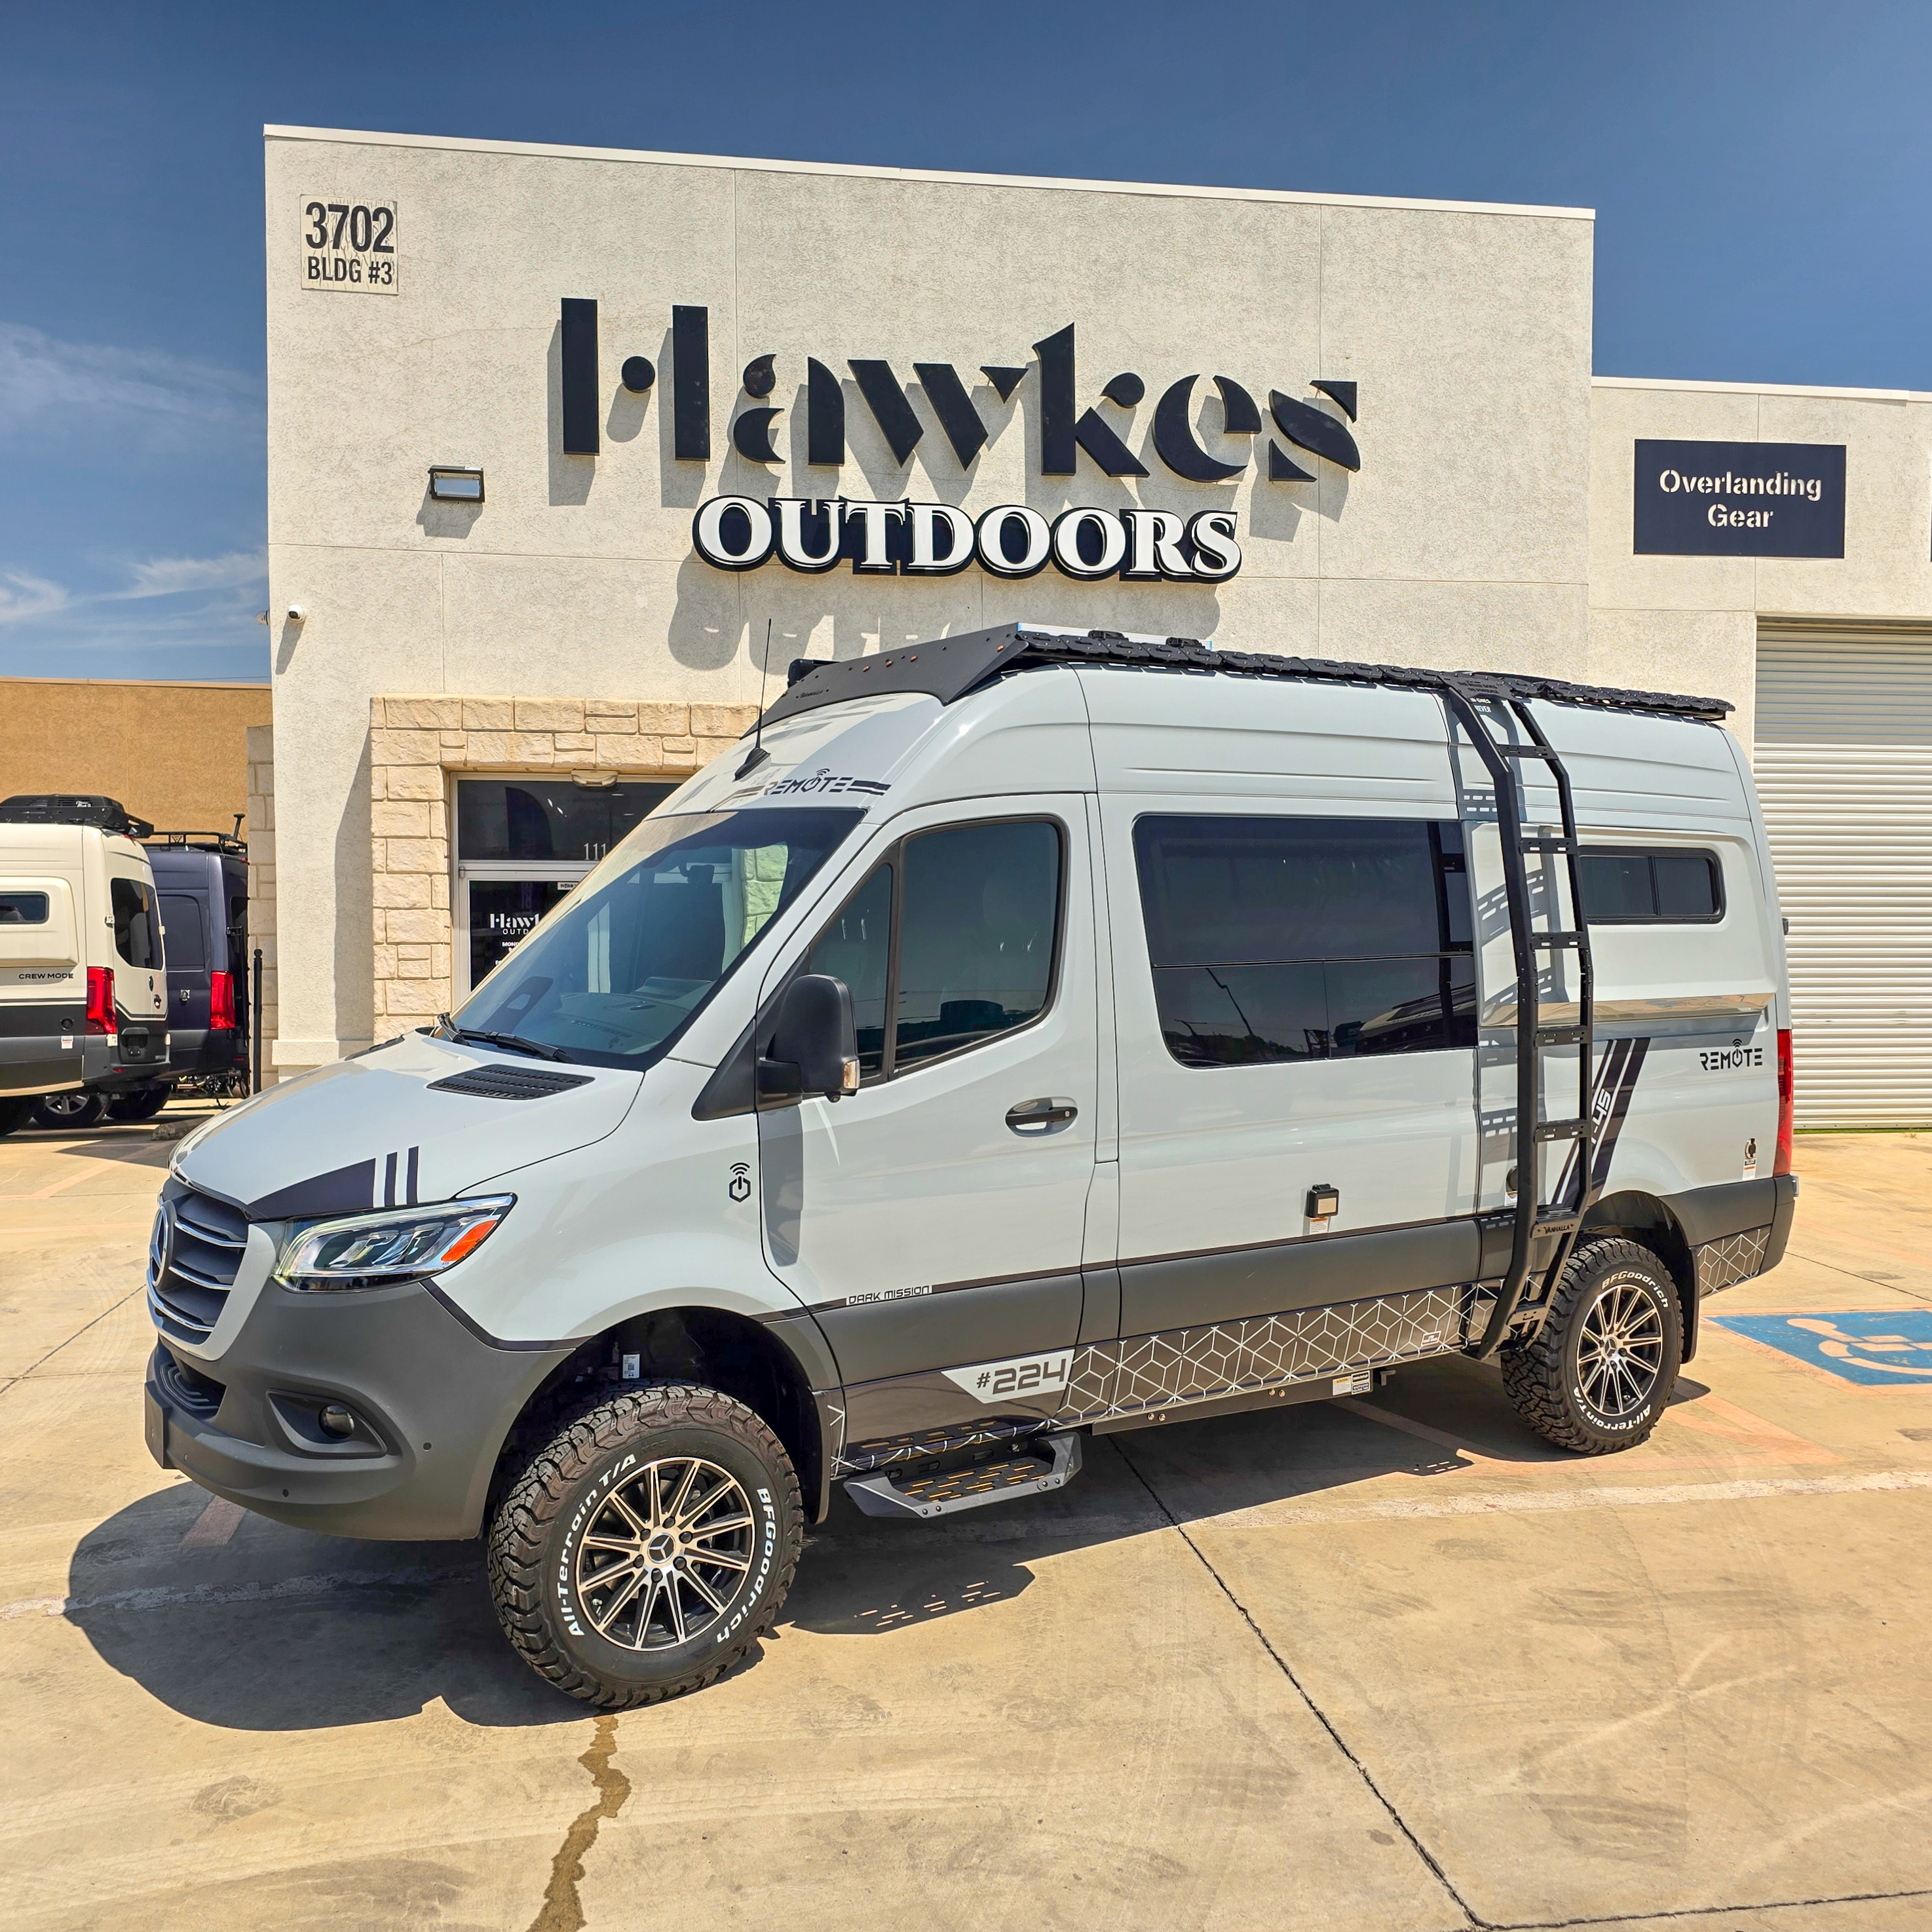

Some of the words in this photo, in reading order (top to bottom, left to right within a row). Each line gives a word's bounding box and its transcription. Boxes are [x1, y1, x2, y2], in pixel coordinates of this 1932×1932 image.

[305, 202, 394, 254] 3702
[308, 256, 362, 283] BLDG
[368, 261, 392, 285] #3
[561, 297, 1360, 483] Hawkes
[1659, 469, 1822, 502] Overlanding
[1707, 504, 1774, 528] Gear
[694, 495, 1243, 580] OUTDOORS
[764, 774, 854, 795] REMOTE
[490, 913, 539, 928] Haw
[1699, 1047, 1763, 1071] REMOTE
[1544, 1224, 1570, 1234] VANHALLA
[848, 1292, 881, 1304] DARK
[884, 1285, 930, 1299] MISSION
[1601, 1270, 1669, 1308] BFGoodrich
[976, 1358, 1067, 1395] #224
[1586, 1404, 1651, 1431] All-Terrain
[558, 1489, 597, 1636] All-Terrain
[599, 1454, 637, 1487] T/A
[717, 1488, 776, 1642] BFGoodrich
